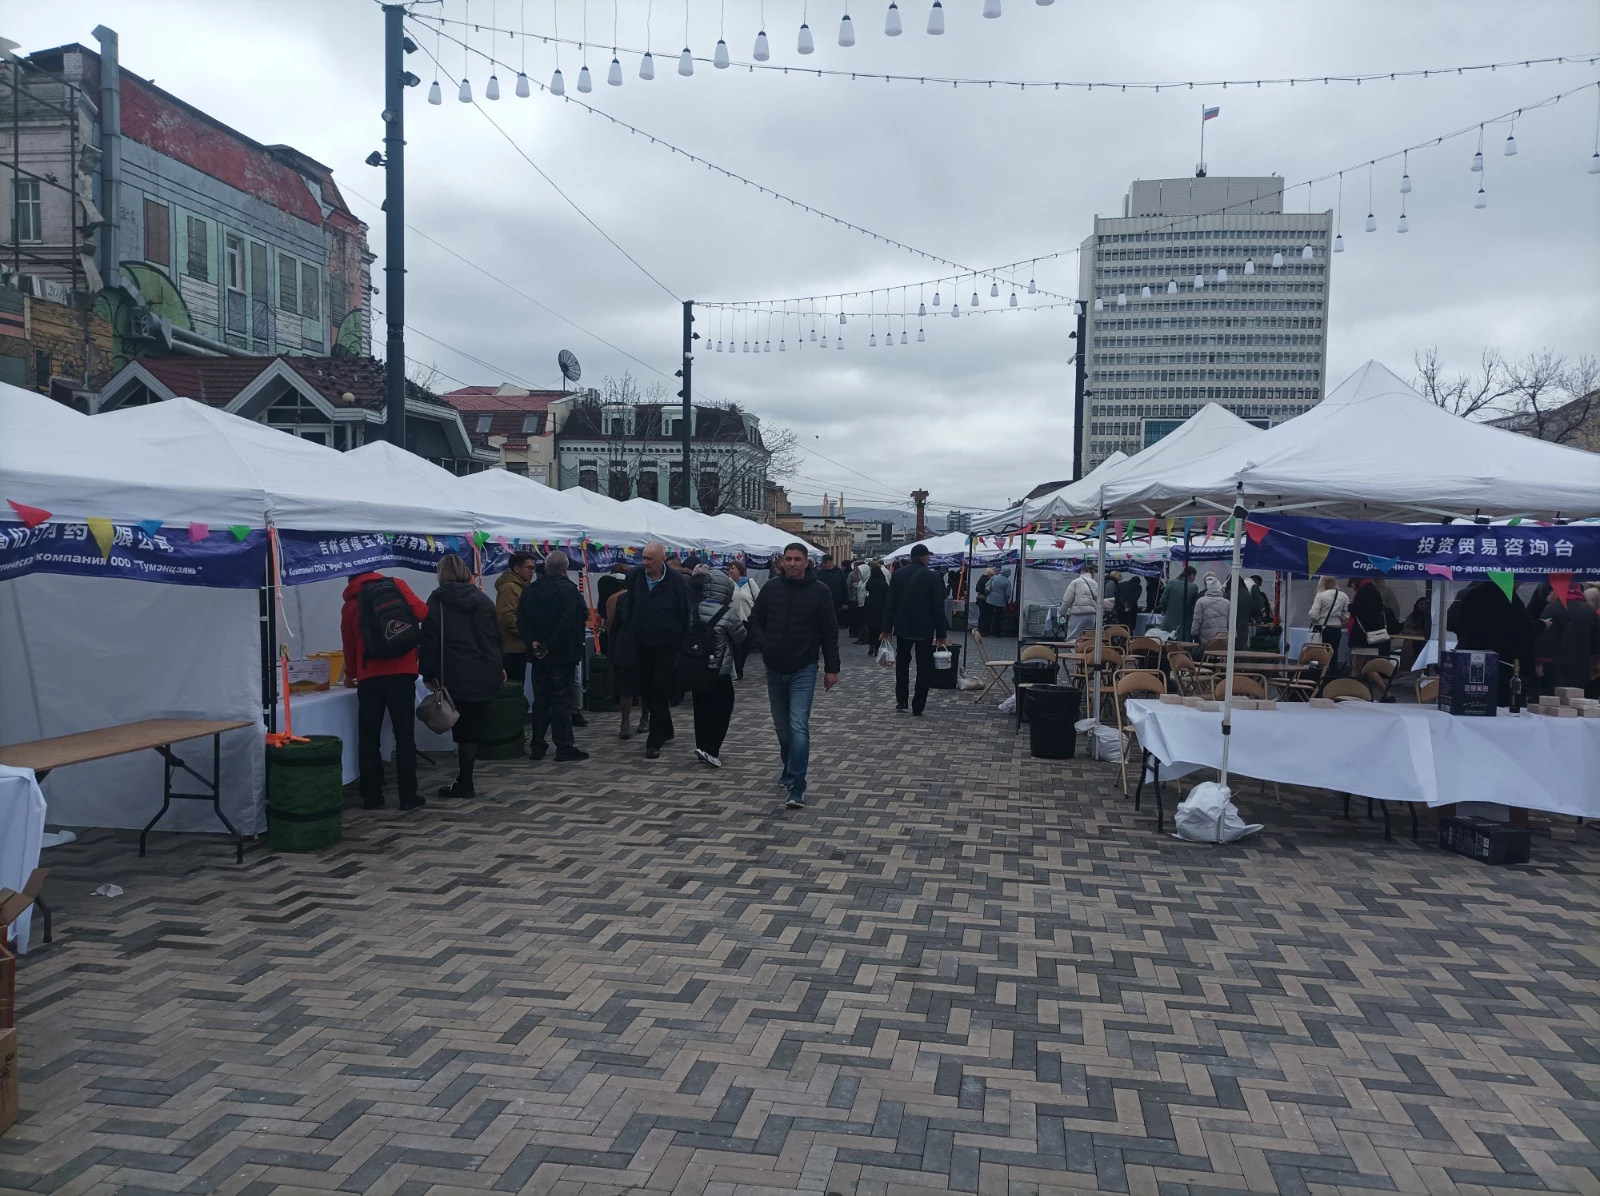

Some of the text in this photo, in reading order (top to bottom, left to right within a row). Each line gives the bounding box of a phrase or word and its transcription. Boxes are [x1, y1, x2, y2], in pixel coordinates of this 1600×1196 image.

[318, 533, 445, 556] 吉林省福玉农技有限司
[1417, 536, 1574, 557] 投资贸易咨询台
[35, 553, 107, 565] компания
[1465, 565, 1501, 573] делам
